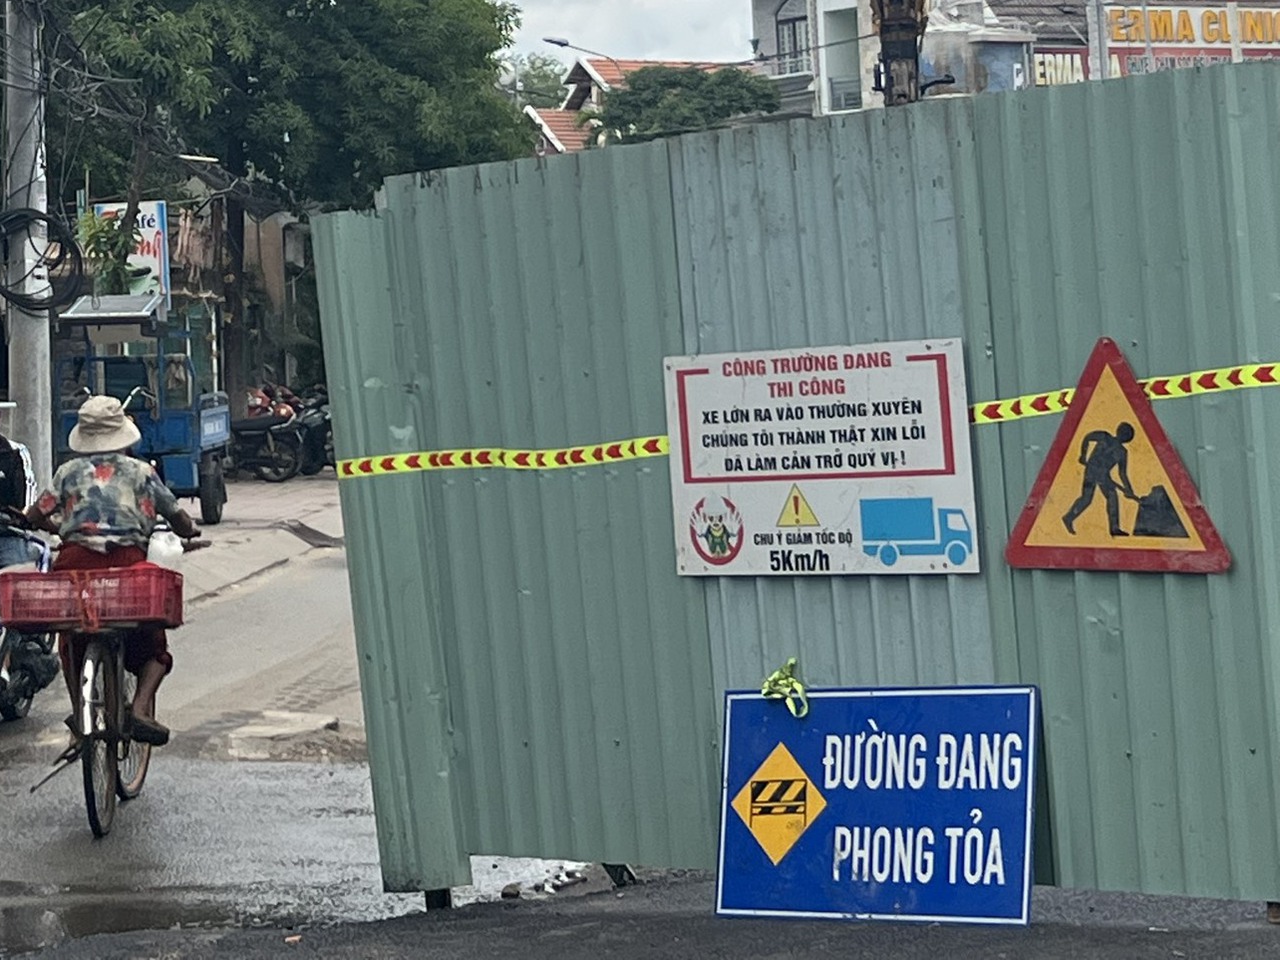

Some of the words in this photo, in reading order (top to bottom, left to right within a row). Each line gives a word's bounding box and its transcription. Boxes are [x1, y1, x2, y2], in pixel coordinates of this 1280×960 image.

[1105, 8, 1195, 43] ERMA
[722, 358, 766, 377] CÔNG
[770, 352, 838, 374] TRƯỜNG
[843, 351, 892, 370] ĐANG
[767, 381, 794, 398] THI
[799, 376, 846, 396] CÔNG
[702, 410, 719, 424] XE
[723, 404, 750, 424] LỚN
[754, 408, 772, 422] RA
[776, 402, 804, 420] VÀO
[808, 400, 867, 419] THƯỜNG
[872, 396, 922, 417] XUYÊN
[702, 429, 748, 448] CHÚNG
[752, 429, 774, 446] TÔI
[778, 427, 826, 445] THÀNH
[830, 424, 866, 446] THẬT
[871, 427, 897, 441] XIN
[902, 419, 926, 440] LỖI
[747, 453, 777, 471] LÀM
[781, 450, 811, 470] CẢN
[815, 448, 843, 469] TRỞ
[847, 448, 876, 469] QUÝ
[769, 549, 830, 571] 5Km/h
[822, 719, 927, 790] ĐƯỜNG
[936, 733, 1022, 790] ĐANG
[832, 826, 935, 883] PHONG
[944, 808, 1005, 885] TỎA
